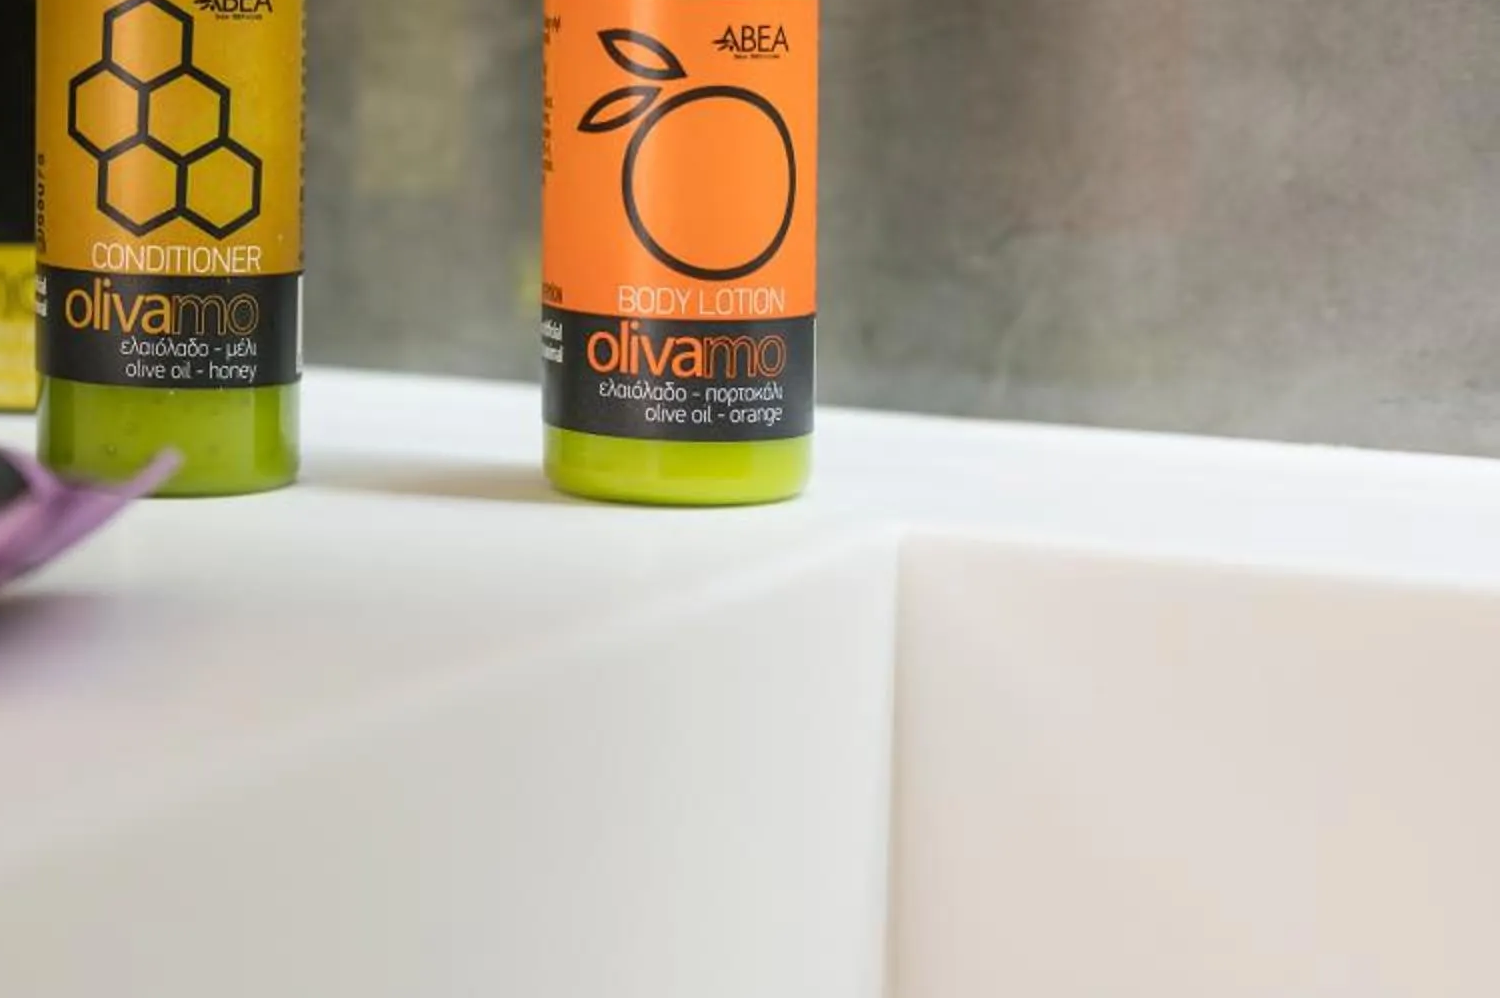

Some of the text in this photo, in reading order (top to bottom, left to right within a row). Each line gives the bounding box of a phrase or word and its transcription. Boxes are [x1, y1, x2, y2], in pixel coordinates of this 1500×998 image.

[712, 25, 789, 52] ABEA
[91, 241, 262, 274] CONDITIONER
[64, 277, 260, 337] olivamo
[617, 284, 785, 315] BODY LOTION
[586, 319, 787, 379] olivamo
[124, 360, 165, 379] olive
[170, 362, 191, 379] oil
[208, 362, 258, 383] honey
[644, 405, 687, 423] olive
[691, 405, 712, 424] oil
[729, 406, 783, 427] orange
